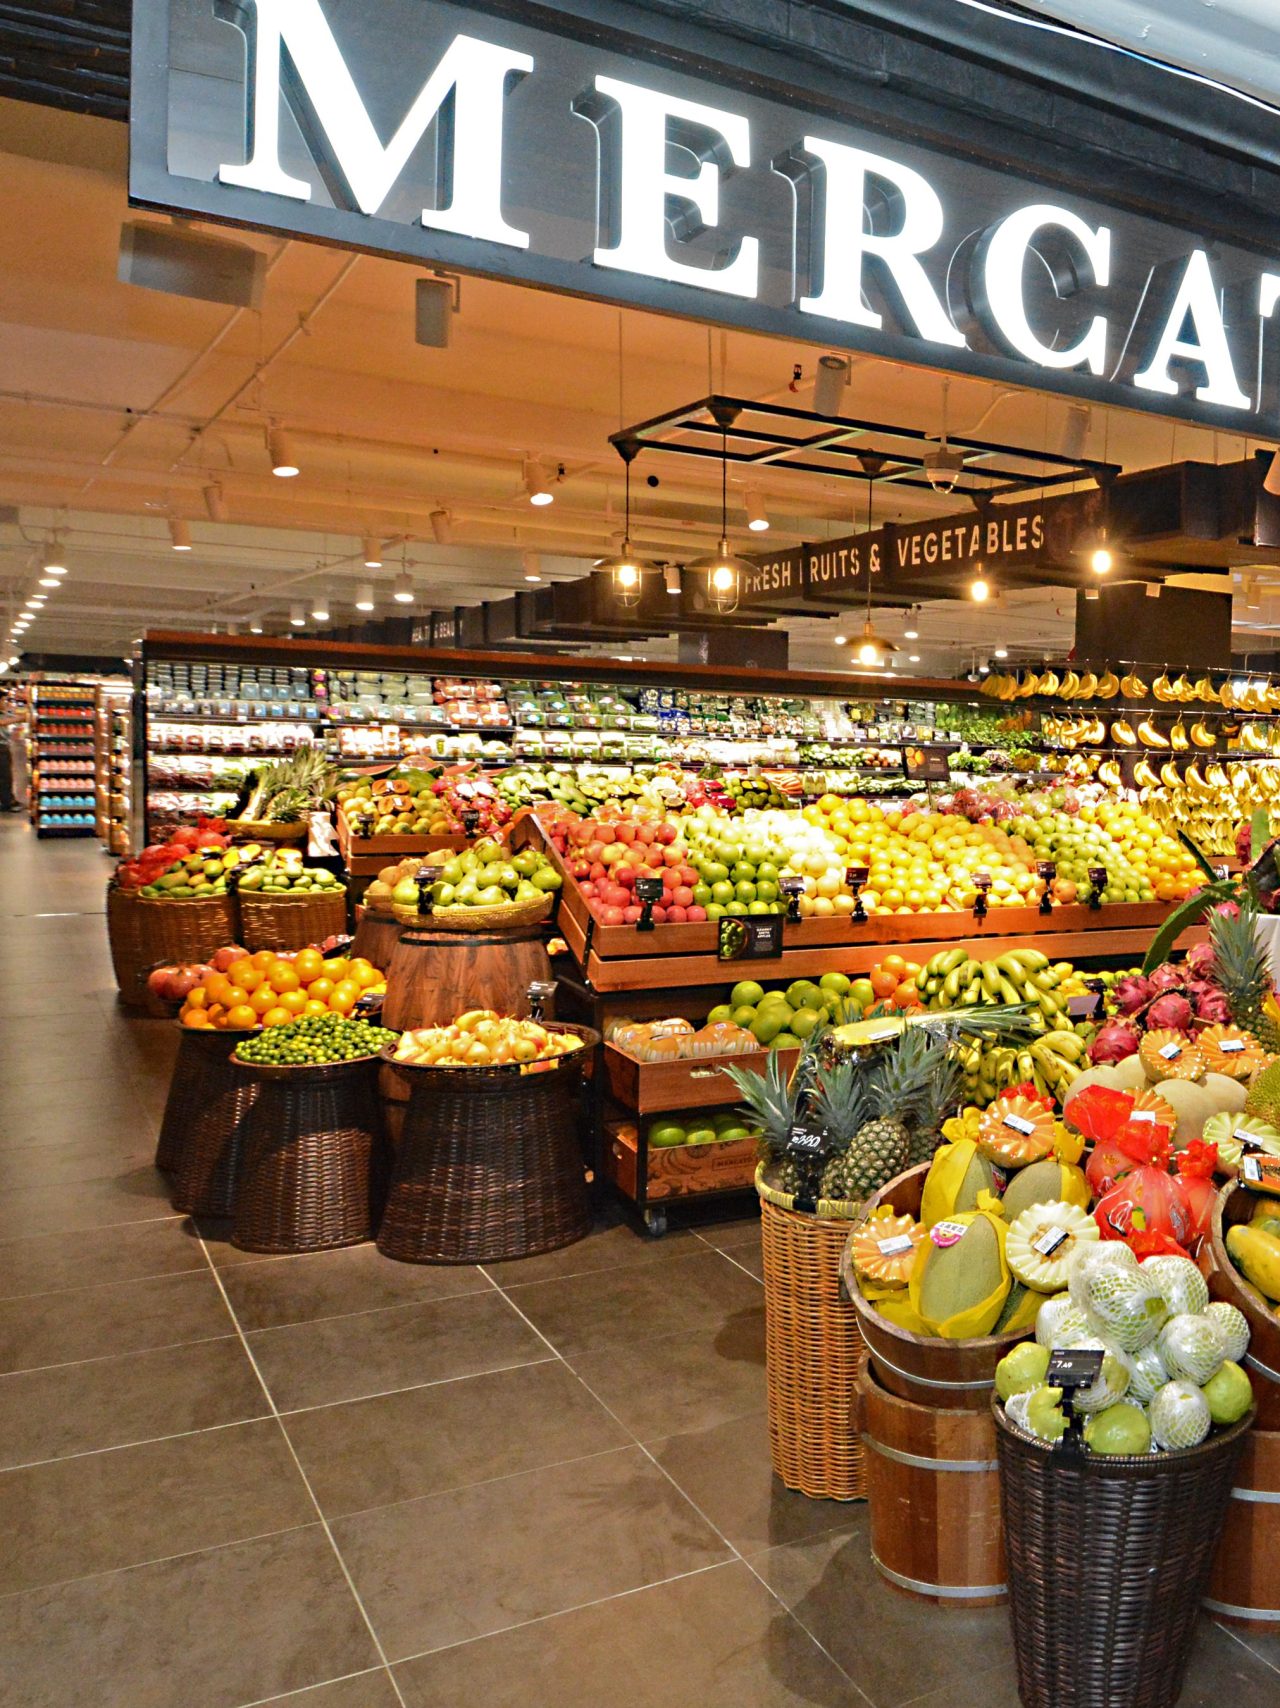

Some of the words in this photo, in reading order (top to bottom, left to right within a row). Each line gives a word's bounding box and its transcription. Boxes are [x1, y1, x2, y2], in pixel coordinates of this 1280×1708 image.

[799, 547, 860, 585] RUITS
[869, 543, 881, 573] &
[897, 514, 1044, 567] VEGETABLES
